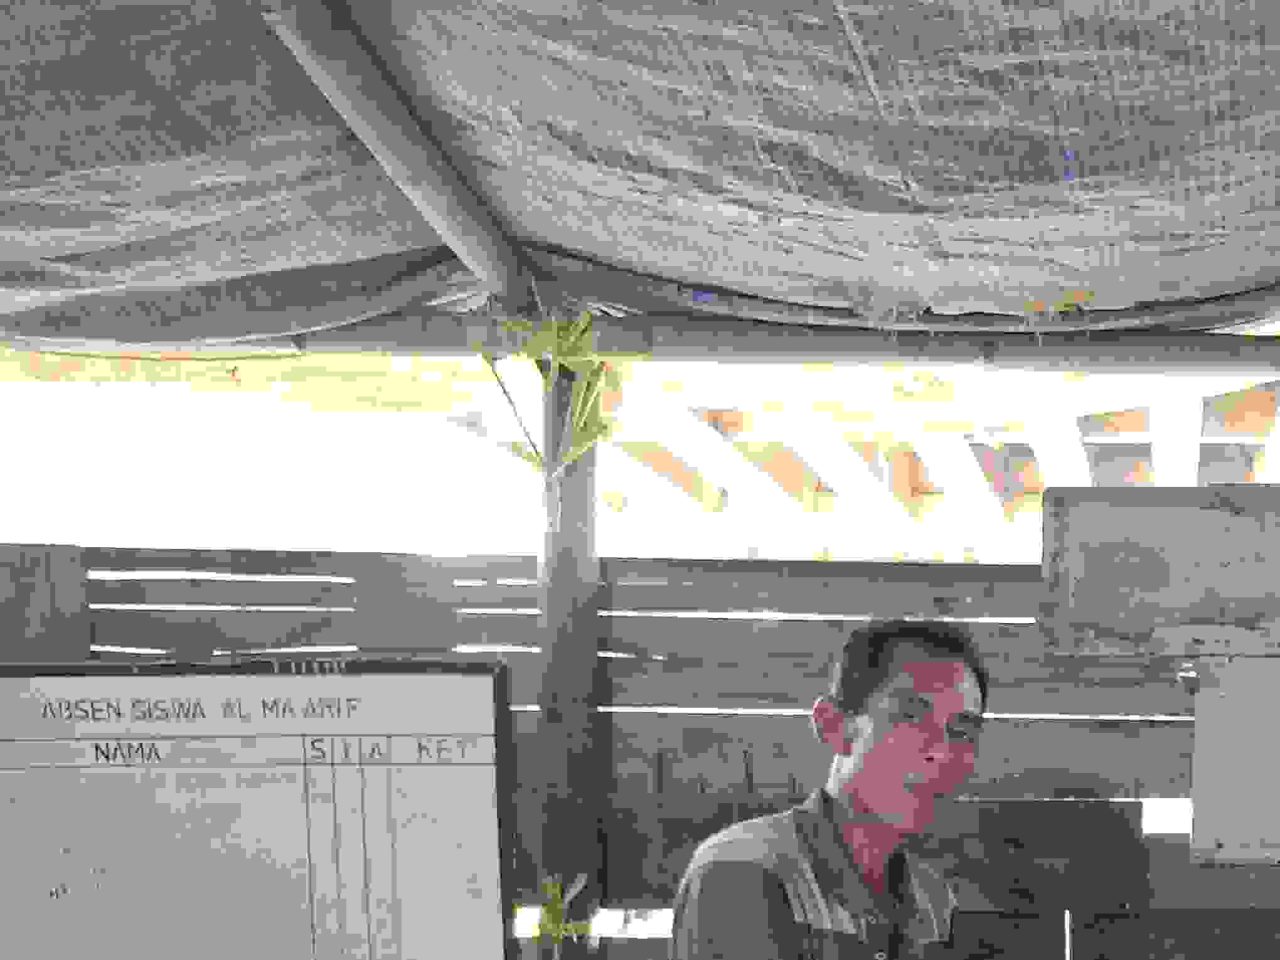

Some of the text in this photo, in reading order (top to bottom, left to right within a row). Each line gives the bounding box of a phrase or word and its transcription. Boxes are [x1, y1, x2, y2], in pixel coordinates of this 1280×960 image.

[41, 699, 122, 720] ABSEN
[130, 699, 207, 721] SISWA
[94, 742, 162, 763] NAMA
[310, 738, 326, 760] S
[367, 742, 383, 760] A
[417, 738, 473, 762] KET
